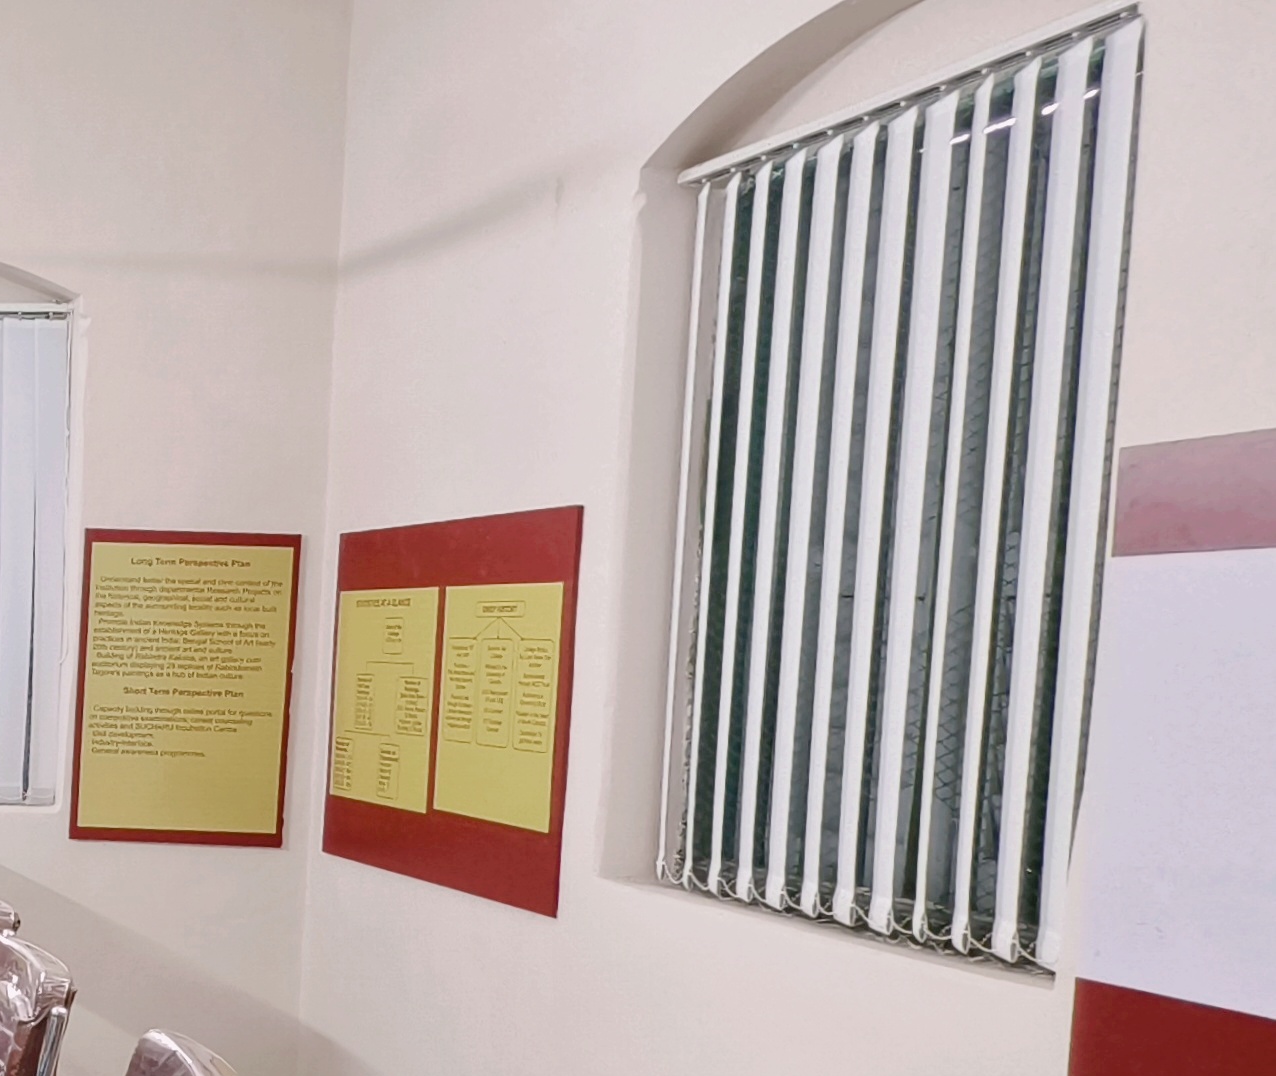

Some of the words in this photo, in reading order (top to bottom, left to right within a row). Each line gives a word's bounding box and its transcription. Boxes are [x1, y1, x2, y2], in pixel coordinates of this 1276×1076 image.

[131, 558, 152, 567] Long
[155, 558, 176, 566] Term
[179, 558, 229, 568] Perspective
[231, 559, 251, 567] Plan
[123, 687, 147, 695] Short
[149, 688, 170, 696] Term
[173, 688, 223, 698] Perspective
[225, 690, 244, 698] Plan
